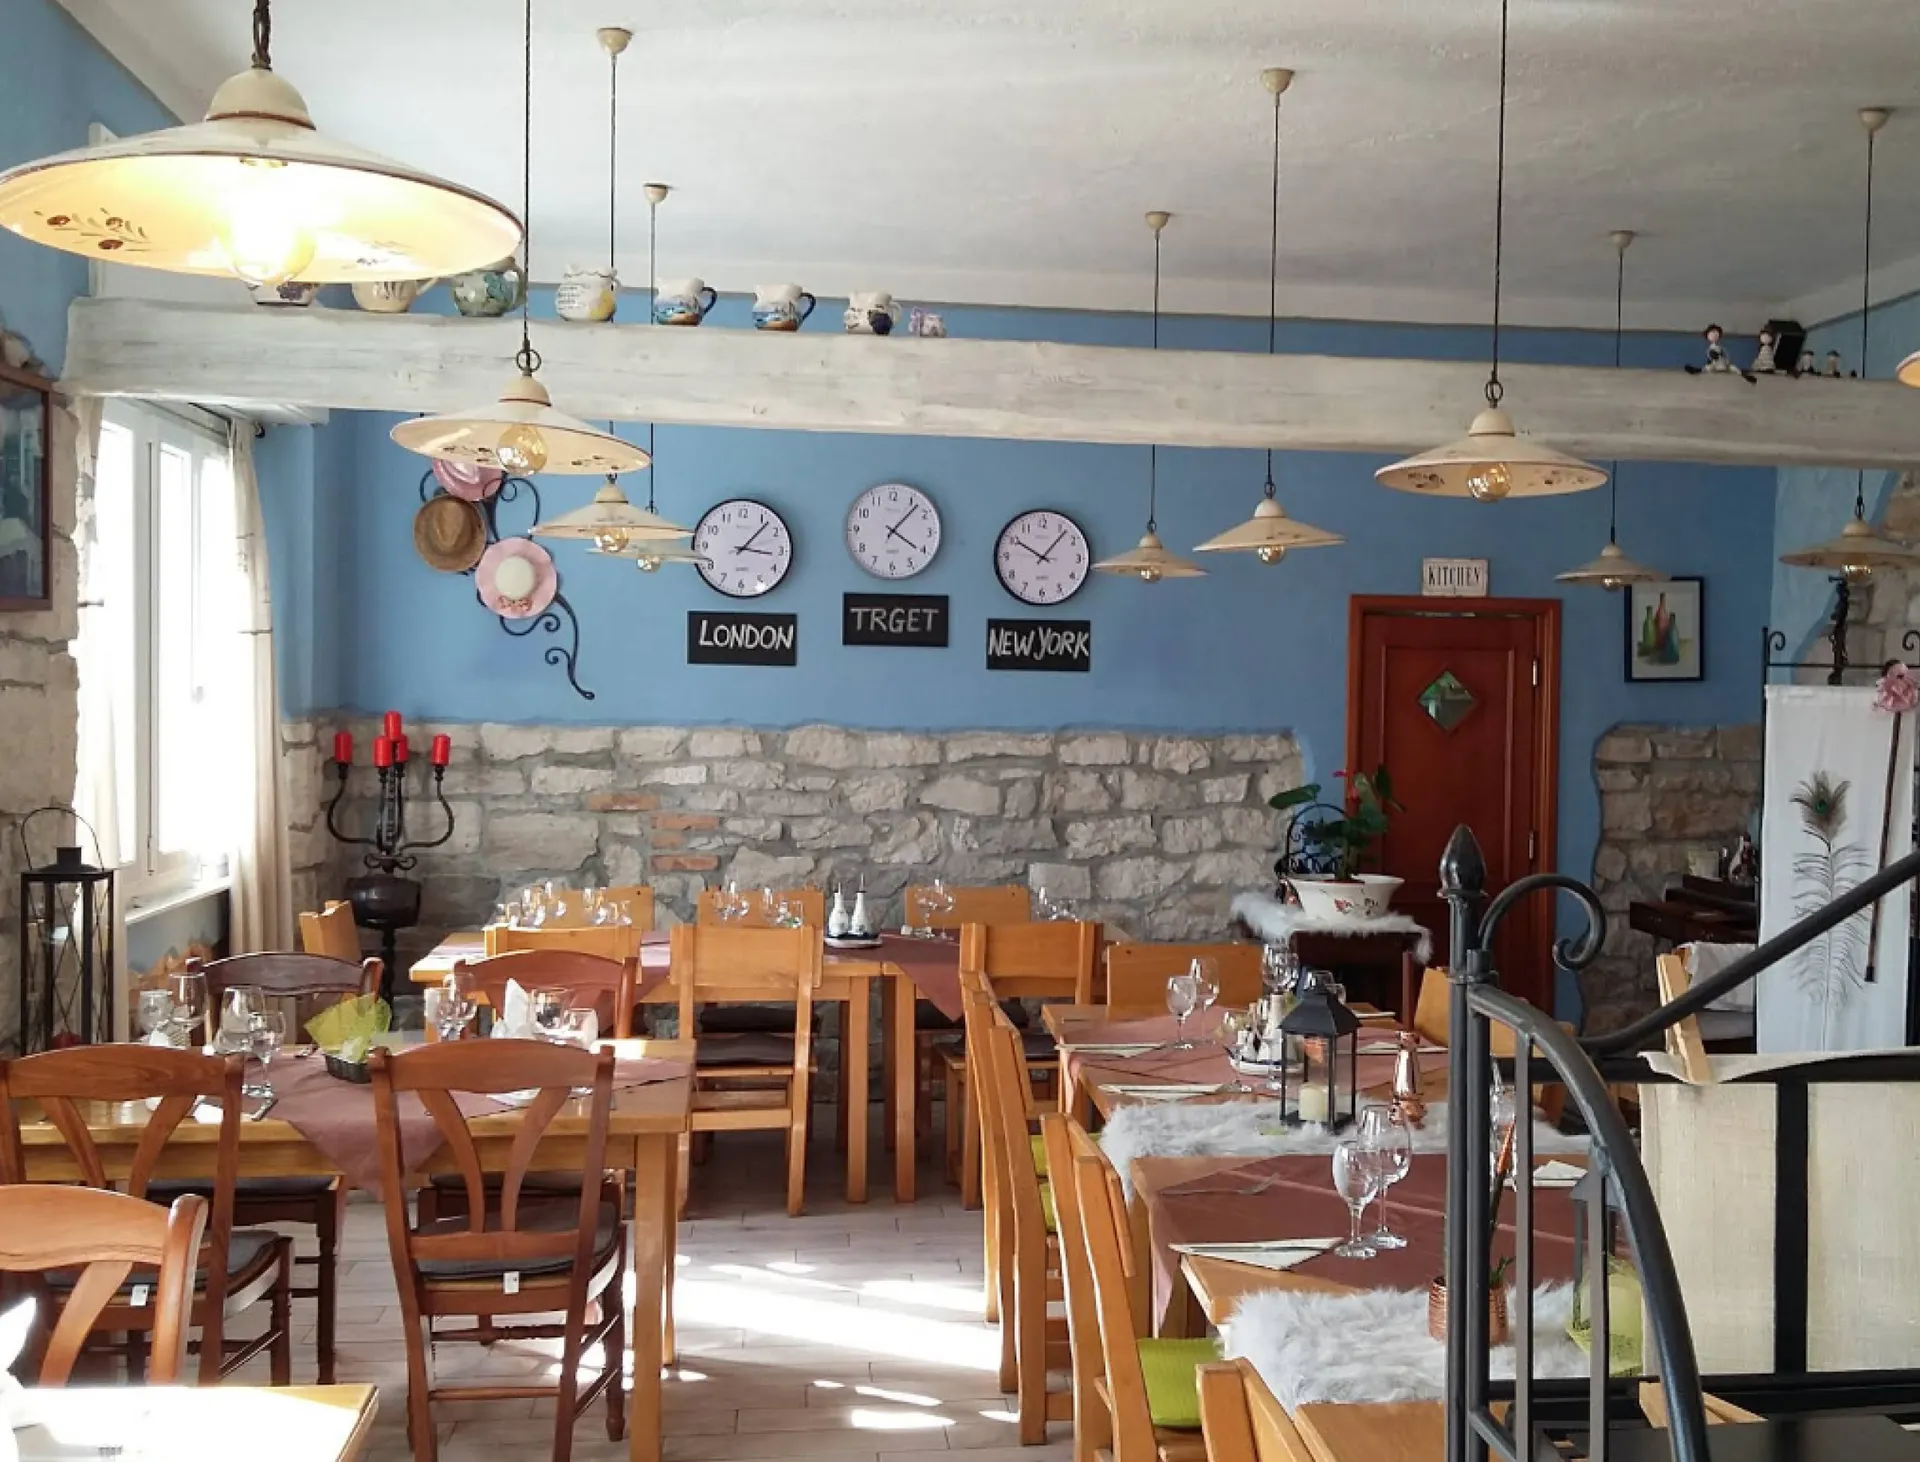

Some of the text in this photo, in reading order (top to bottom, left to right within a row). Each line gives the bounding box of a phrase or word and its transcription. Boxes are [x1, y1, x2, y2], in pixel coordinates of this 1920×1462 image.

[872, 496, 881, 506] 11
[889, 491, 898, 502] 12
[722, 513, 731, 523] 11
[738, 508, 748, 519] 12
[858, 508, 869, 518] 10
[922, 509, 928, 520] 2
[853, 524, 860, 534] 9
[1022, 523, 1030, 534] 11
[1038, 519, 1047, 529] 12
[707, 525, 719, 535] 10
[772, 527, 779, 538] 2
[927, 527, 932, 538] 3
[702, 541, 709, 549] 9
[1010, 535, 1019, 546] 10
[1070, 535, 1076, 546] 2
[778, 546, 784, 557] 3
[859, 542, 865, 553] 8
[920, 544, 926, 555] 4
[872, 555, 879, 565] 7
[1003, 551, 1010, 561] 9
[1076, 553, 1082, 564] 3
[707, 560, 714, 570] 8
[770, 563, 777, 573] 4
[889, 561, 896, 571] 6
[720, 572, 728, 583] 7
[1008, 569, 1015, 580] 8
[1069, 572, 1076, 580] 4
[1428, 565, 1481, 587] KITCHEN
[738, 579, 745, 589] 6
[1022, 581, 1028, 591] 7
[1039, 587, 1046, 596] 6
[850, 607, 940, 633] TRGET
[699, 619, 794, 650] LONDON
